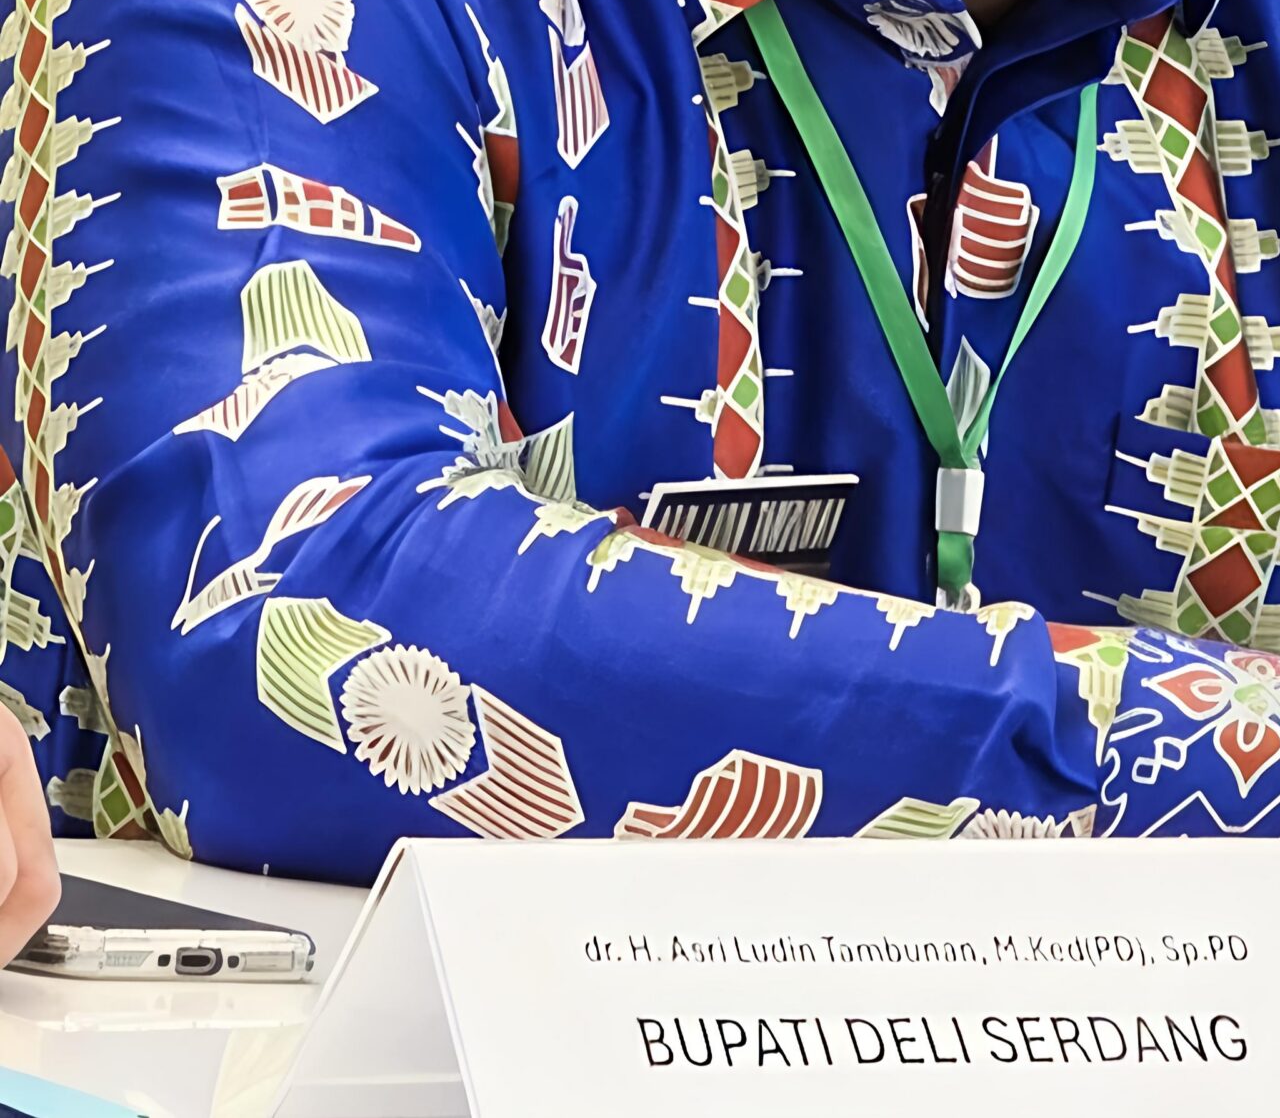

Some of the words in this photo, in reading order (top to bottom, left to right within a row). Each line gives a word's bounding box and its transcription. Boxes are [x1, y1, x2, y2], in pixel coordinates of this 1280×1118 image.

[584, 934, 622, 962] dr.
[628, 934, 663, 962] H.
[671, 934, 727, 963] Asri
[733, 935, 816, 963] Ludin
[820, 935, 988, 966] Tambunan,
[1161, 934, 1248, 967] Sp.PD
[636, 1017, 834, 1067] BUPATI
[844, 1017, 972, 1065] DELI
[981, 1014, 1249, 1064] SERDANG
